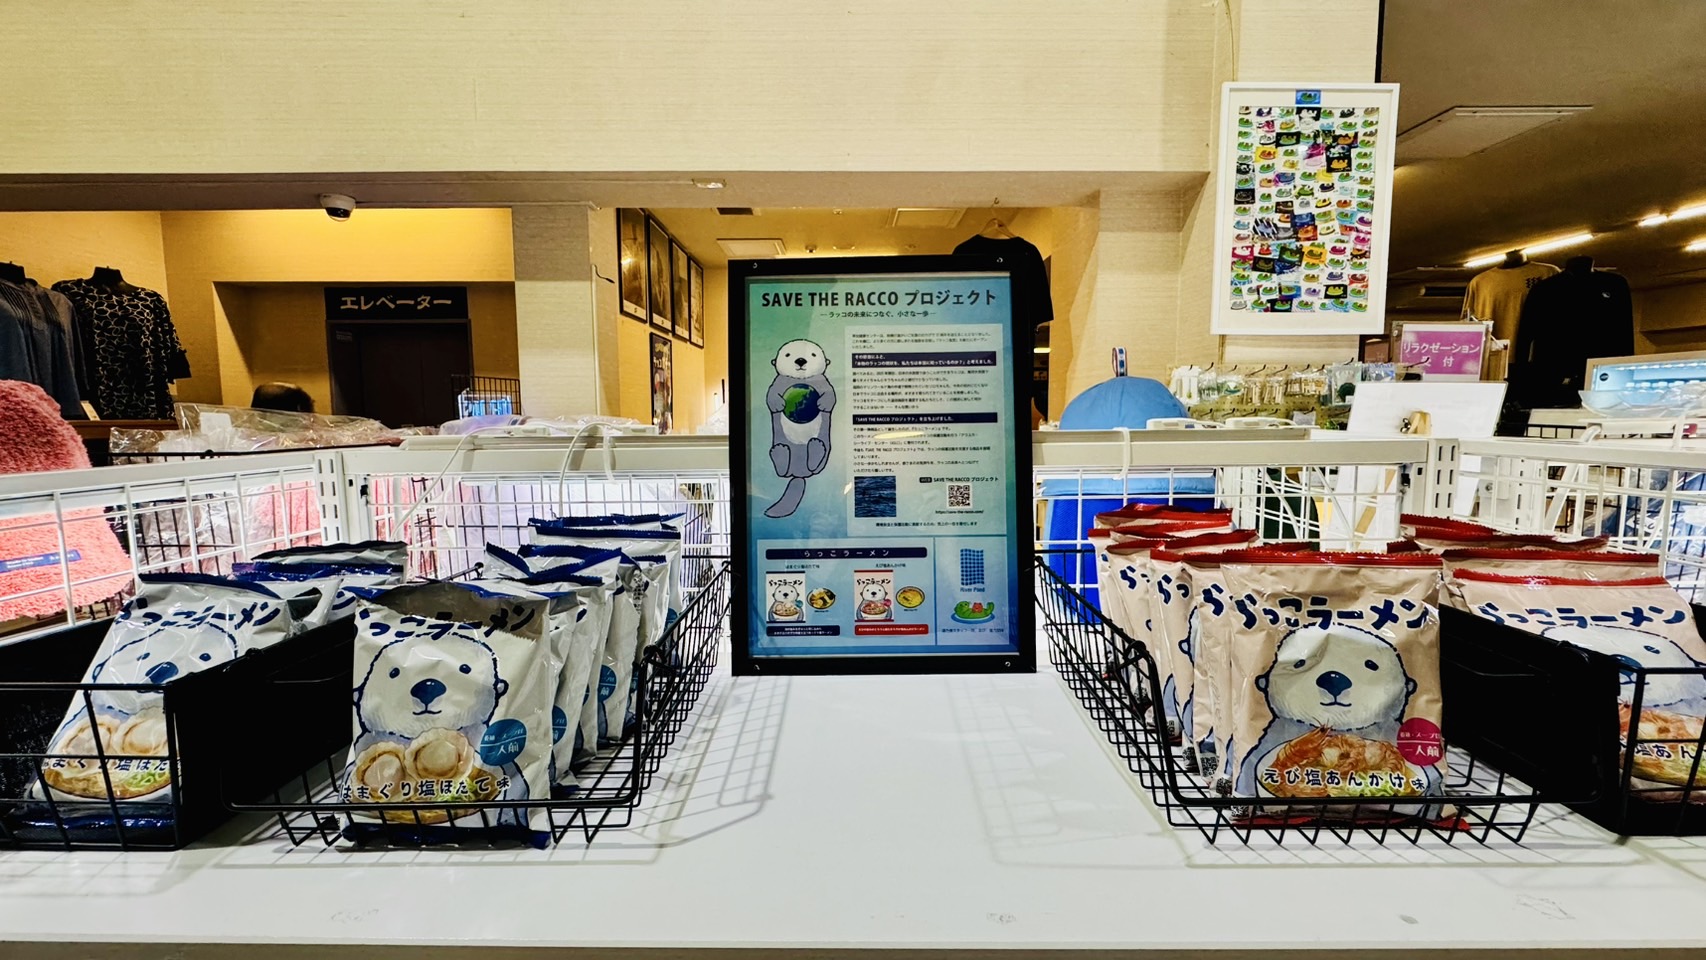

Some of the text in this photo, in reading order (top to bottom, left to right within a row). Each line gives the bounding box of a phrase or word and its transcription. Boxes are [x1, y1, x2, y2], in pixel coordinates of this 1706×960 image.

[340, 295, 452, 310] エレベーター
[762, 289, 997, 307] SAVE THE RACCO プロジェクト
[1403, 342, 1480, 354] リラクゼーション
[804, 549, 890, 558] らっこラーメン
[1234, 593, 1430, 631] らっこラーメン
[1478, 602, 1686, 630] らっこラーメン
[359, 604, 535, 641] っこラーメン
[1404, 744, 1440, 758] 一人前
[341, 776, 512, 800] はまぐり塩ほたて味
[1263, 768, 1426, 791] えび塩あんかけ味
